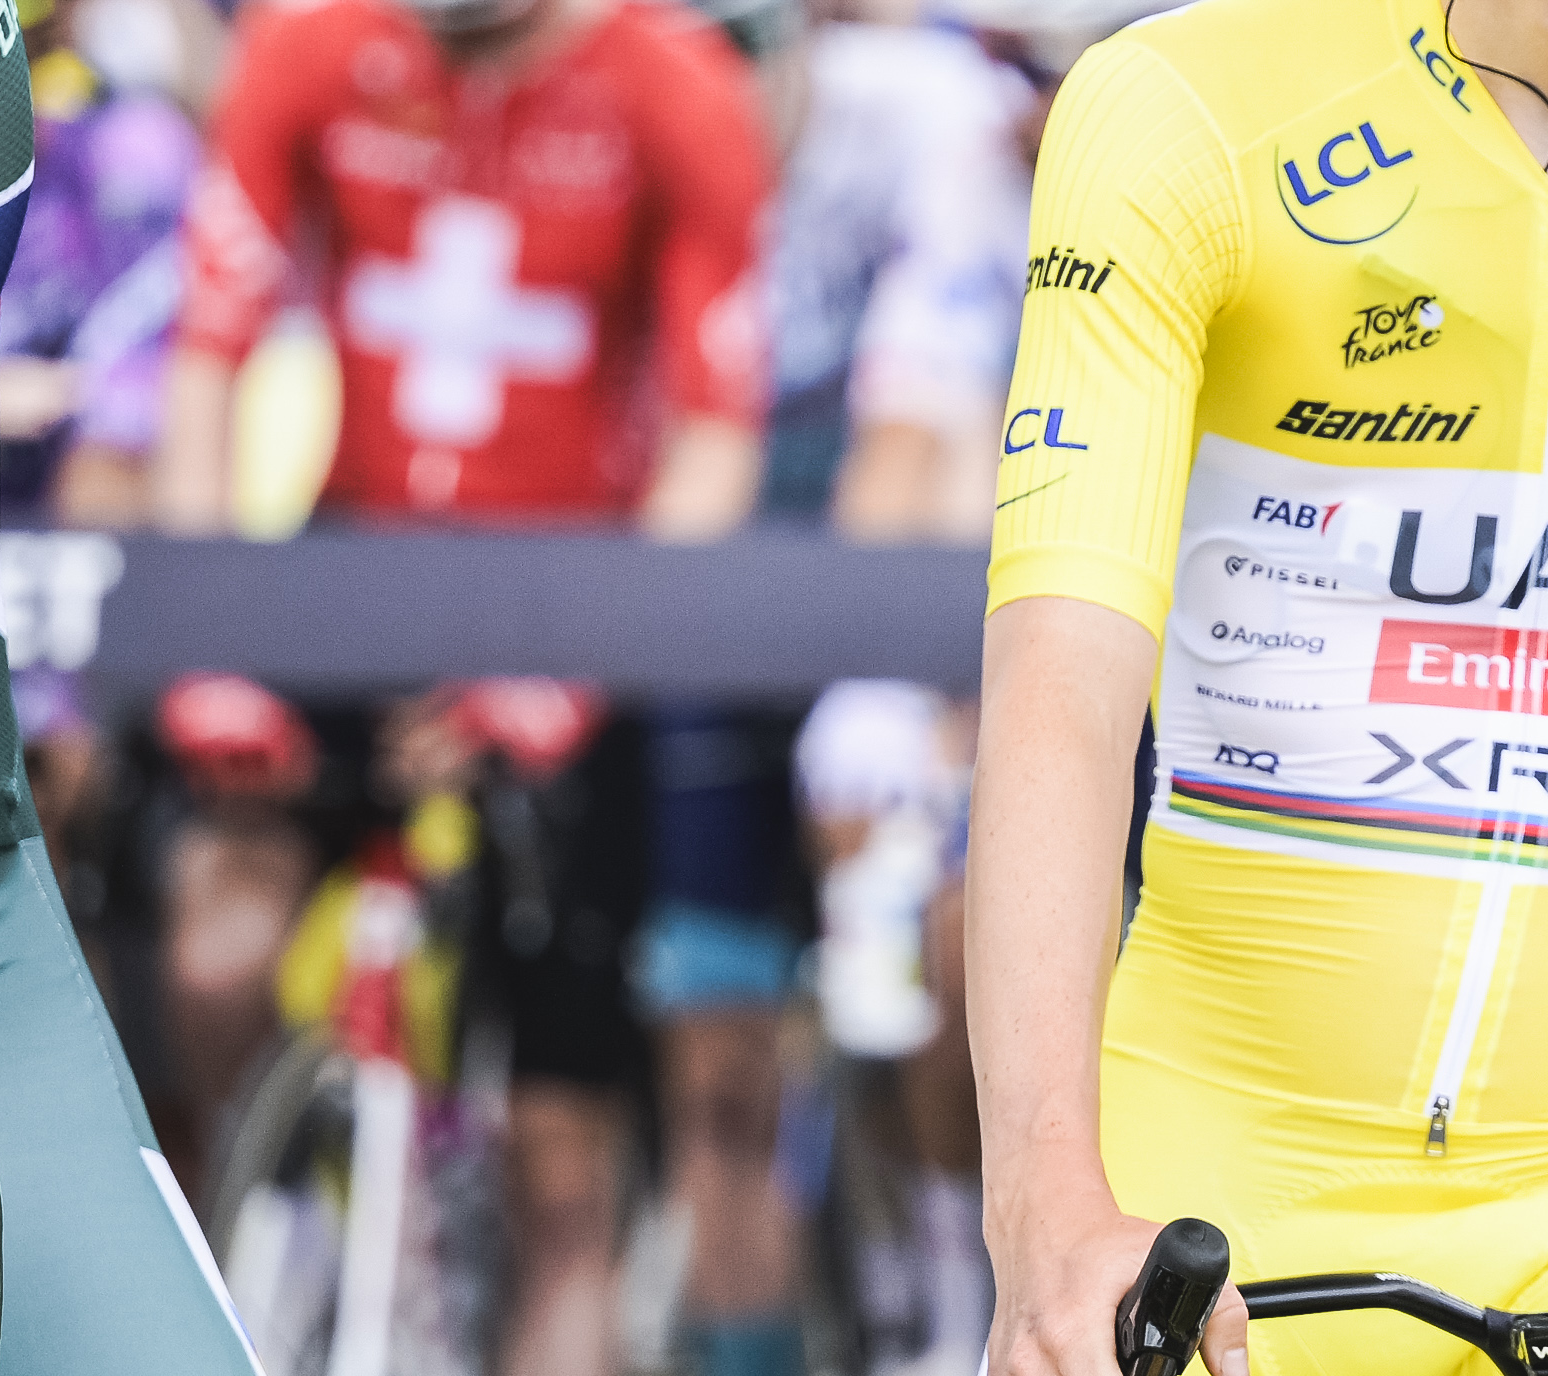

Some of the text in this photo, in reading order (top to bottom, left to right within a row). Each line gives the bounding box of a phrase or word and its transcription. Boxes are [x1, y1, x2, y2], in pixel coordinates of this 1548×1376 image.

[1409, 27, 1471, 113] LCL
[1283, 122, 1414, 208] LCL
[1026, 245, 1116, 295] ntini
[1002, 407, 1089, 454] CL
[1275, 398, 1481, 443] Santini
[1249, 562, 1339, 591] PISSEI
